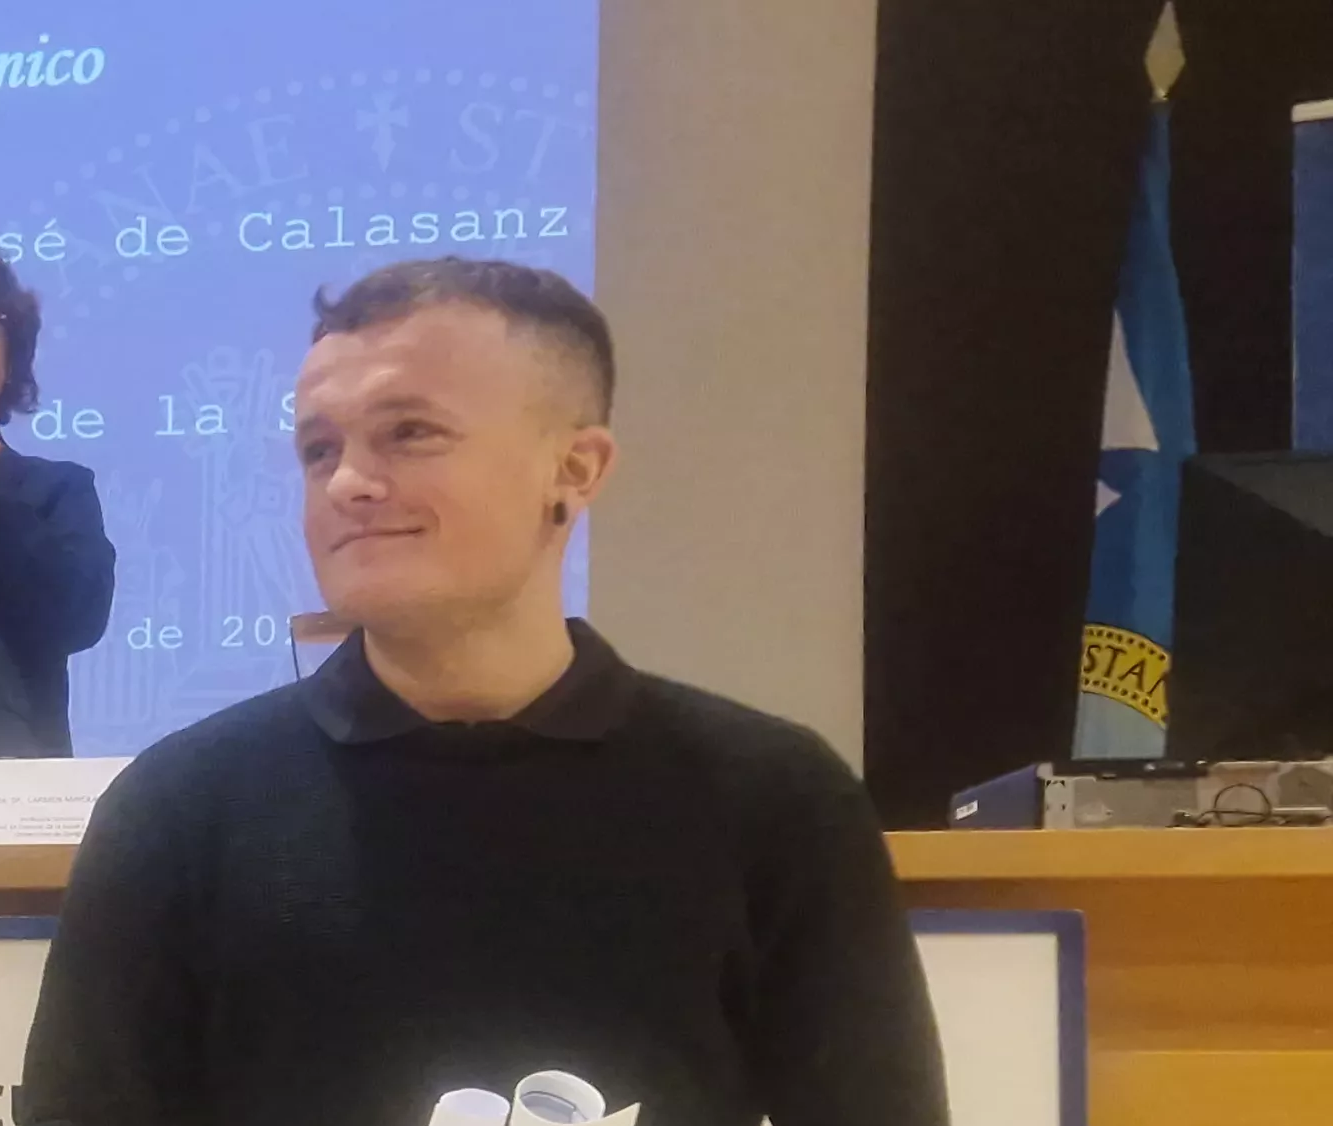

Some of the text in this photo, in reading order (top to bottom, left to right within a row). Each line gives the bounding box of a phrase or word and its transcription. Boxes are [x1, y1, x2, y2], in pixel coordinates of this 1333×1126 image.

[115, 215, 190, 258] de
[239, 206, 570, 252] Calasanz
[31, 399, 105, 440] de
[154, 394, 228, 436] la
[127, 614, 293, 650] de 20
